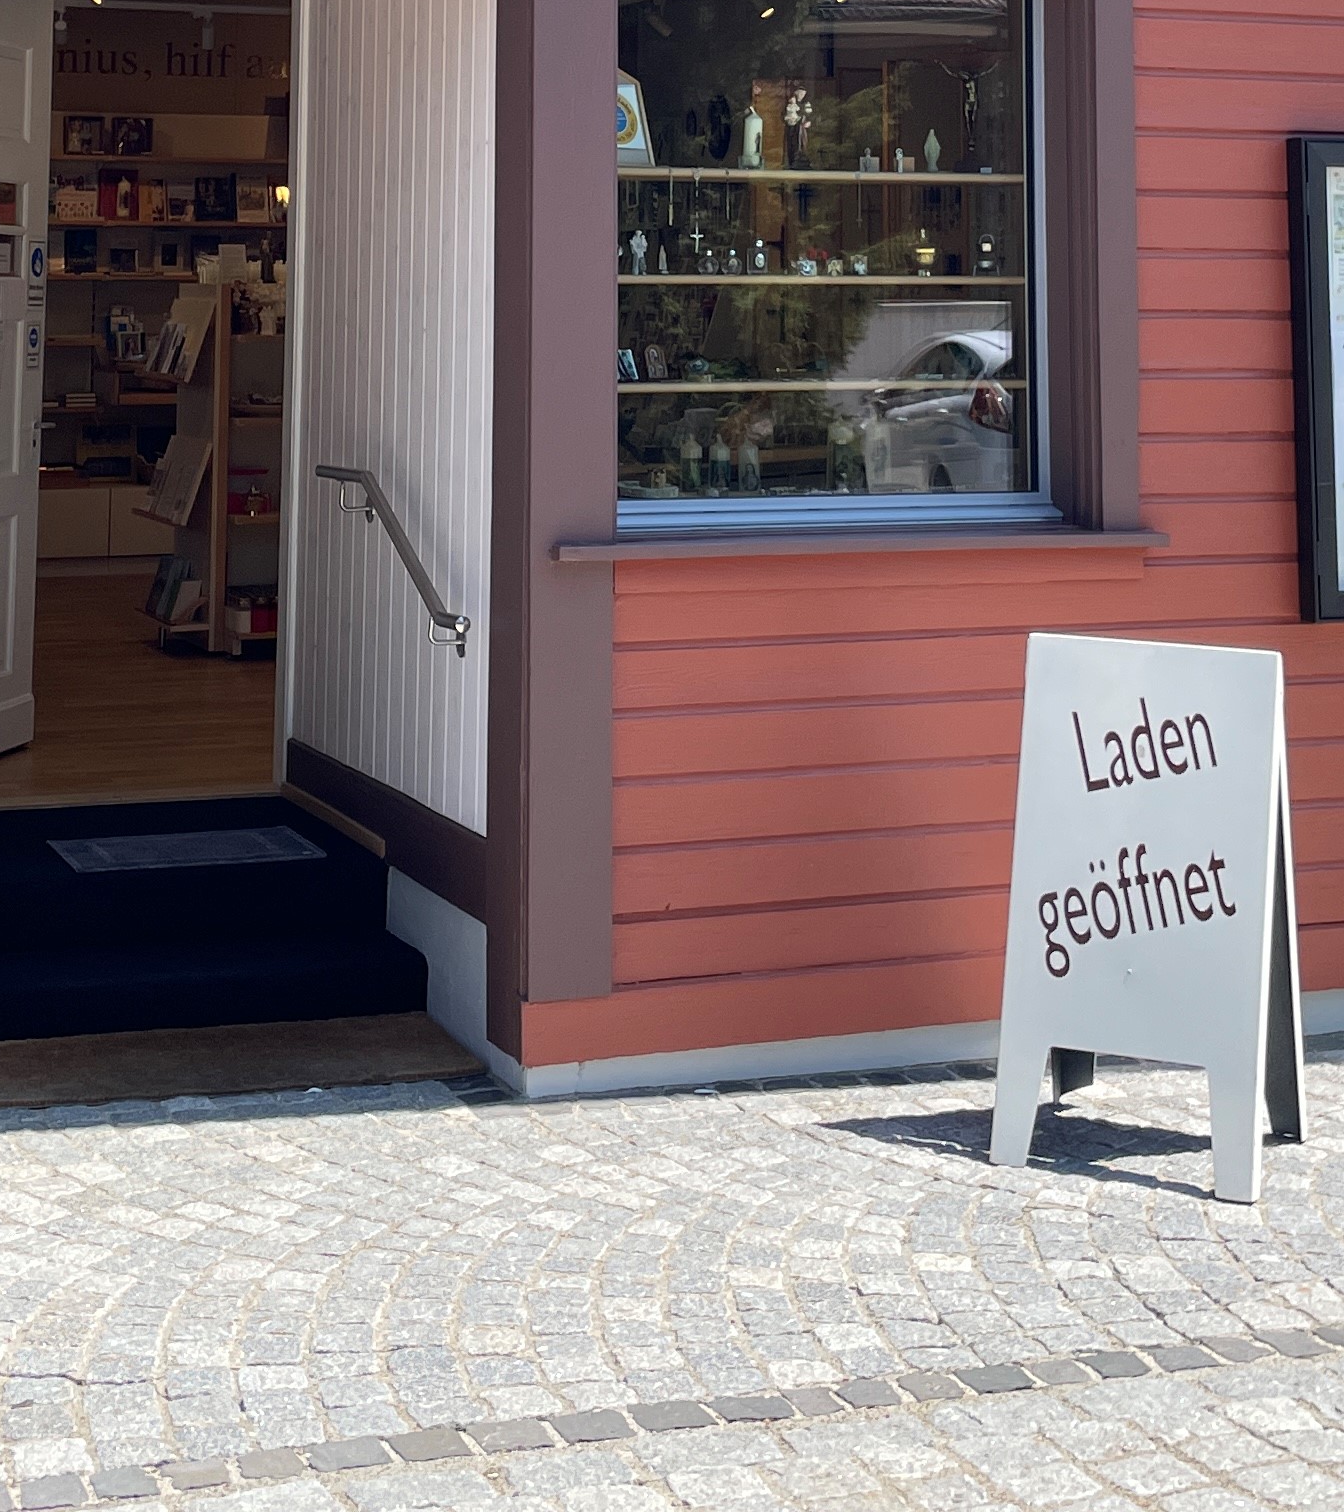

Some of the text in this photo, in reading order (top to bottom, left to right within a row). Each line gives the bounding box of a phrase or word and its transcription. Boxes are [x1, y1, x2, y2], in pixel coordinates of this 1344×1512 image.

[165, 42, 235, 78] hilf
[1071, 696, 1218, 792] Laden
[1038, 843, 1236, 978] geöffnet
